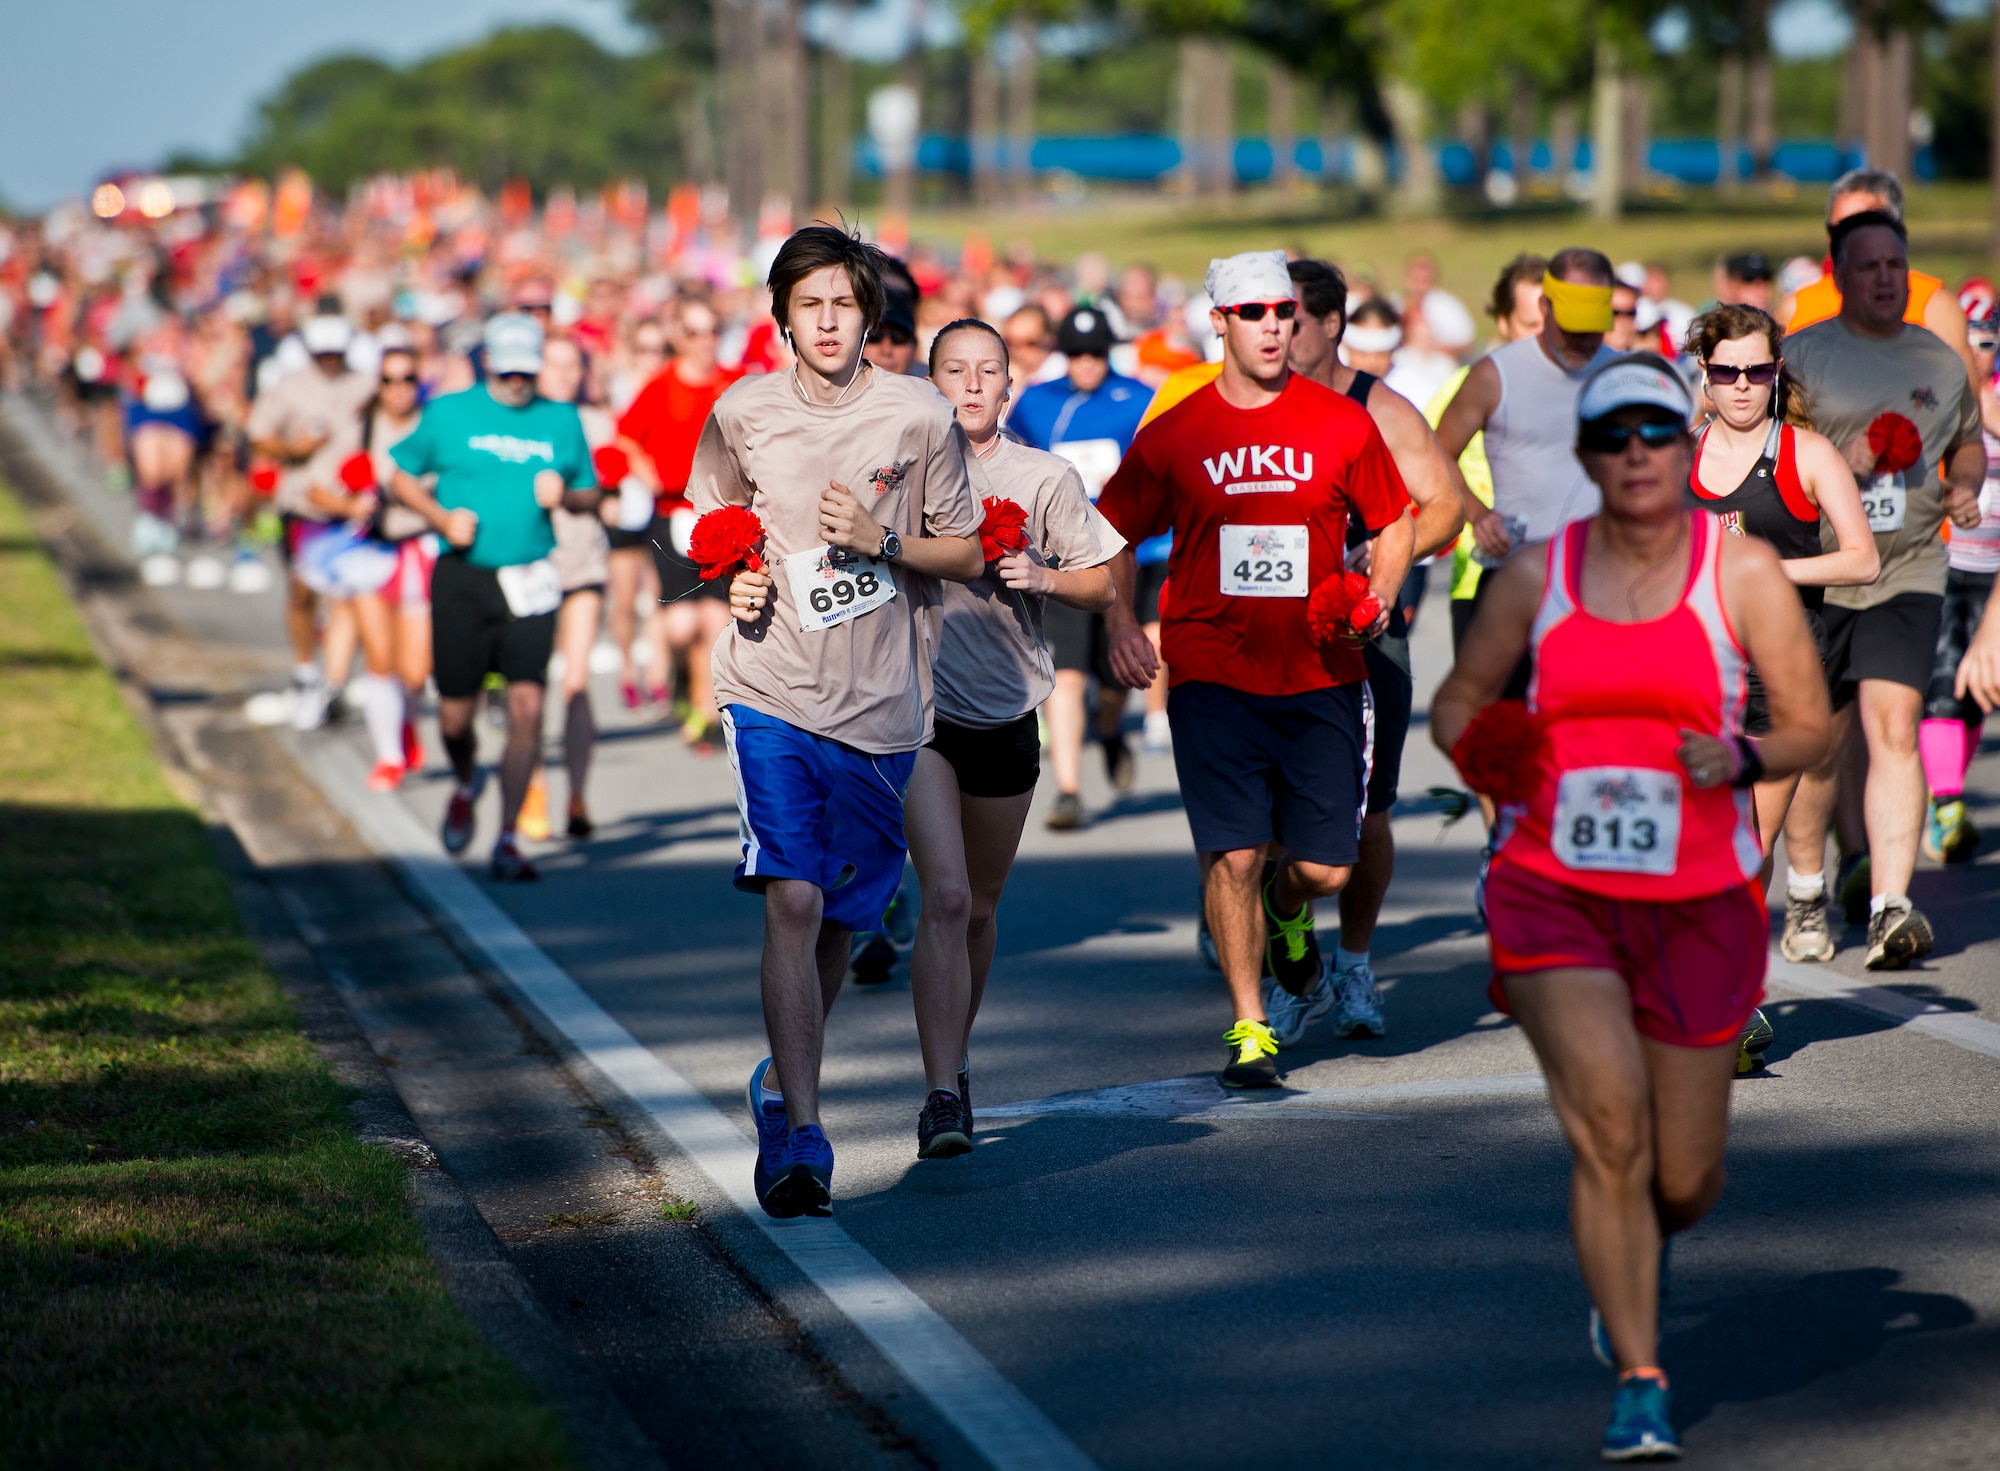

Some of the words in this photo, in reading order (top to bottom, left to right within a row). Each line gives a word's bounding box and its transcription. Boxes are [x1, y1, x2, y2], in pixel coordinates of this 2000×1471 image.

[1202, 445, 1313, 486] WKU
[1231, 482, 1290, 493] BASEBALL
[1234, 560, 1294, 582] 423
[810, 571, 880, 613] 698
[1571, 814, 1657, 852] 813
